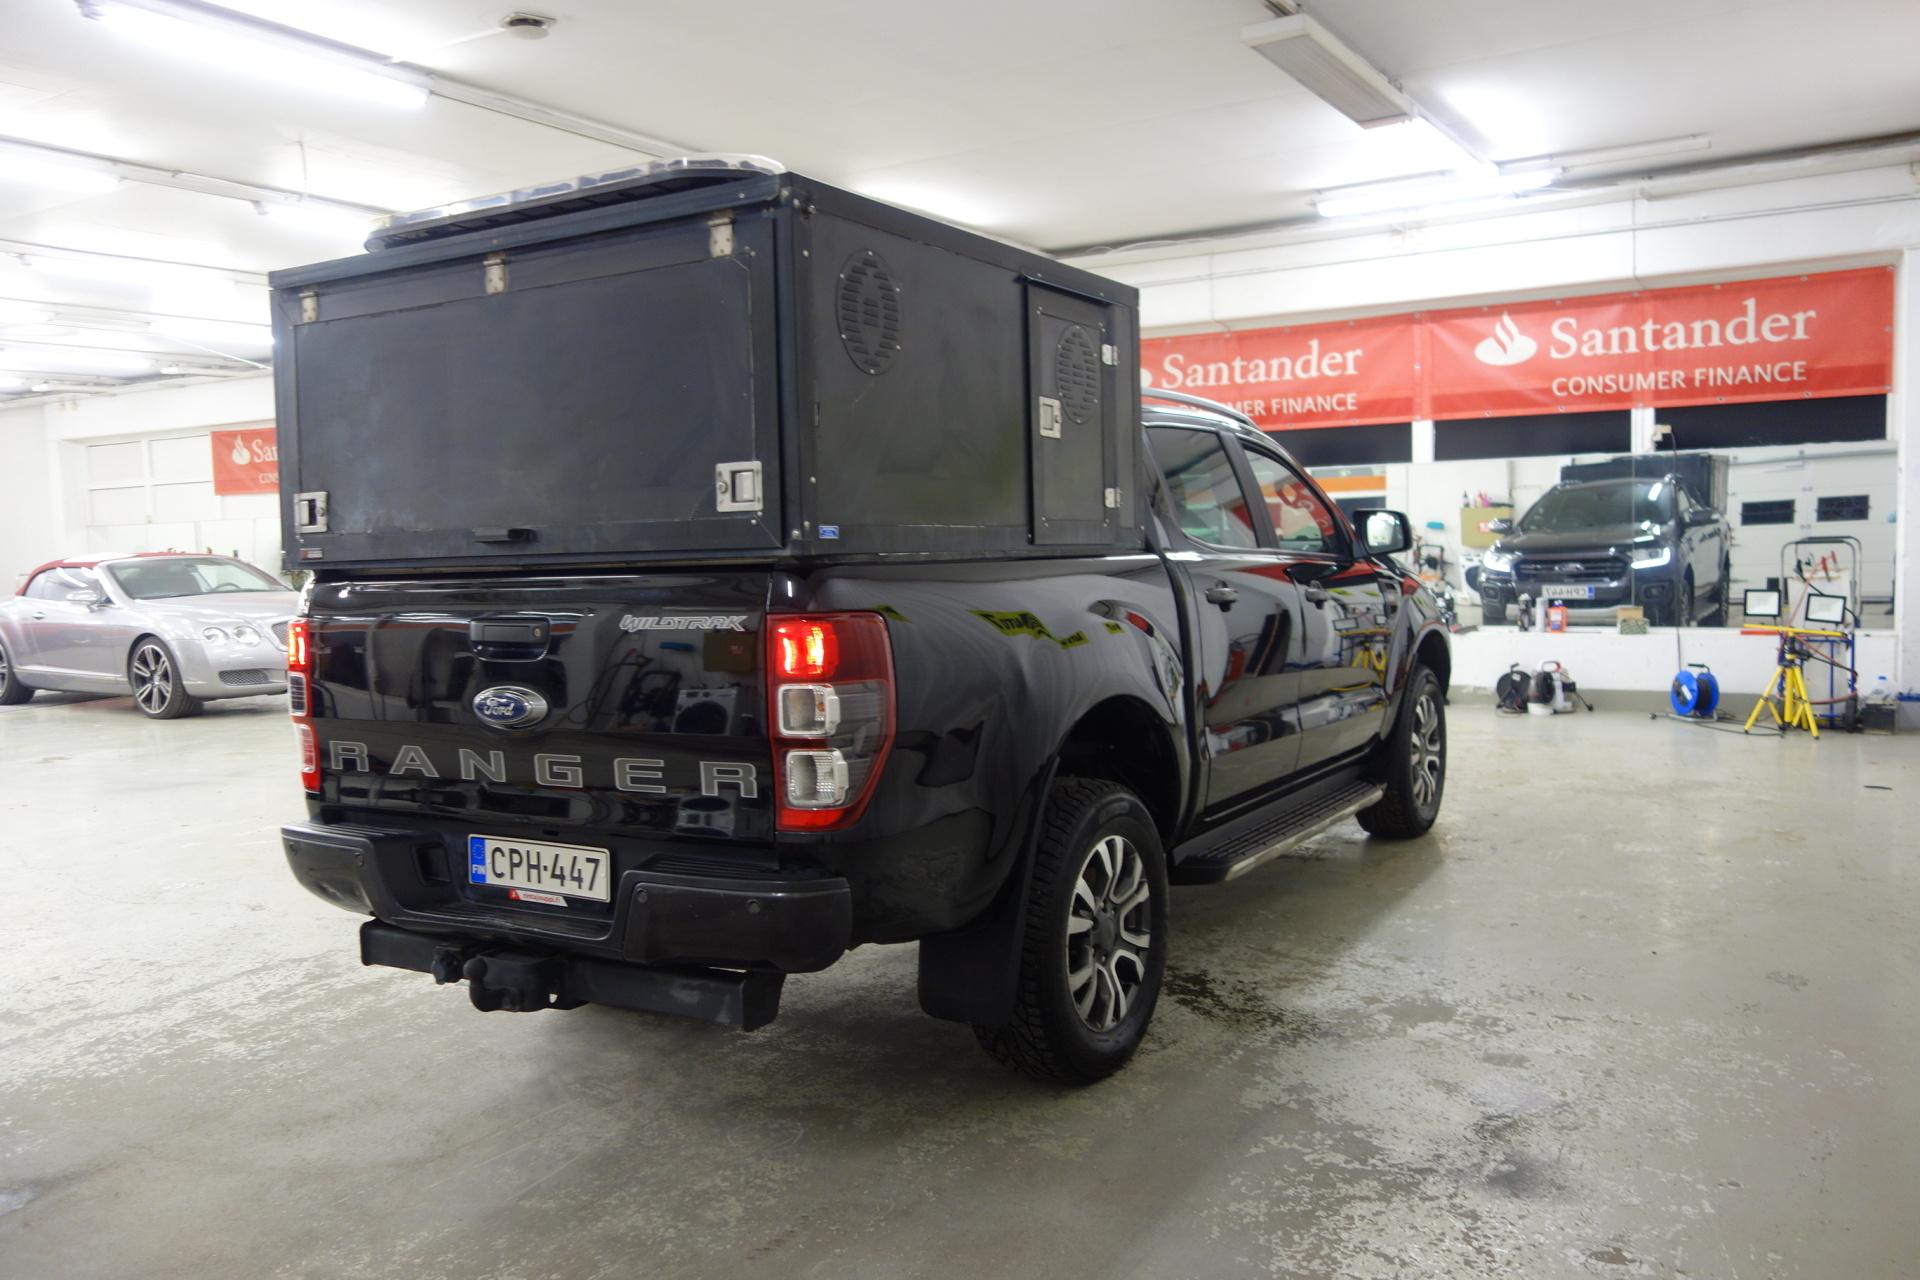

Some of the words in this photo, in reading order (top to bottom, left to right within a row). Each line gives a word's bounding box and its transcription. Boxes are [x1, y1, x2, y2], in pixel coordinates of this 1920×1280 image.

[1549, 297, 1817, 360] Santander
[1161, 339, 1364, 389] Santander
[1551, 370, 1686, 397] CONSUMER
[1694, 361, 1808, 388] FINANCE
[1271, 393, 1358, 415] FINANCE
[618, 614, 750, 632] WILDTRAK
[483, 697, 515, 716] Ford
[328, 740, 759, 798] RANGER
[472, 864, 486, 875] FIN
[491, 846, 600, 891] CPH-447
